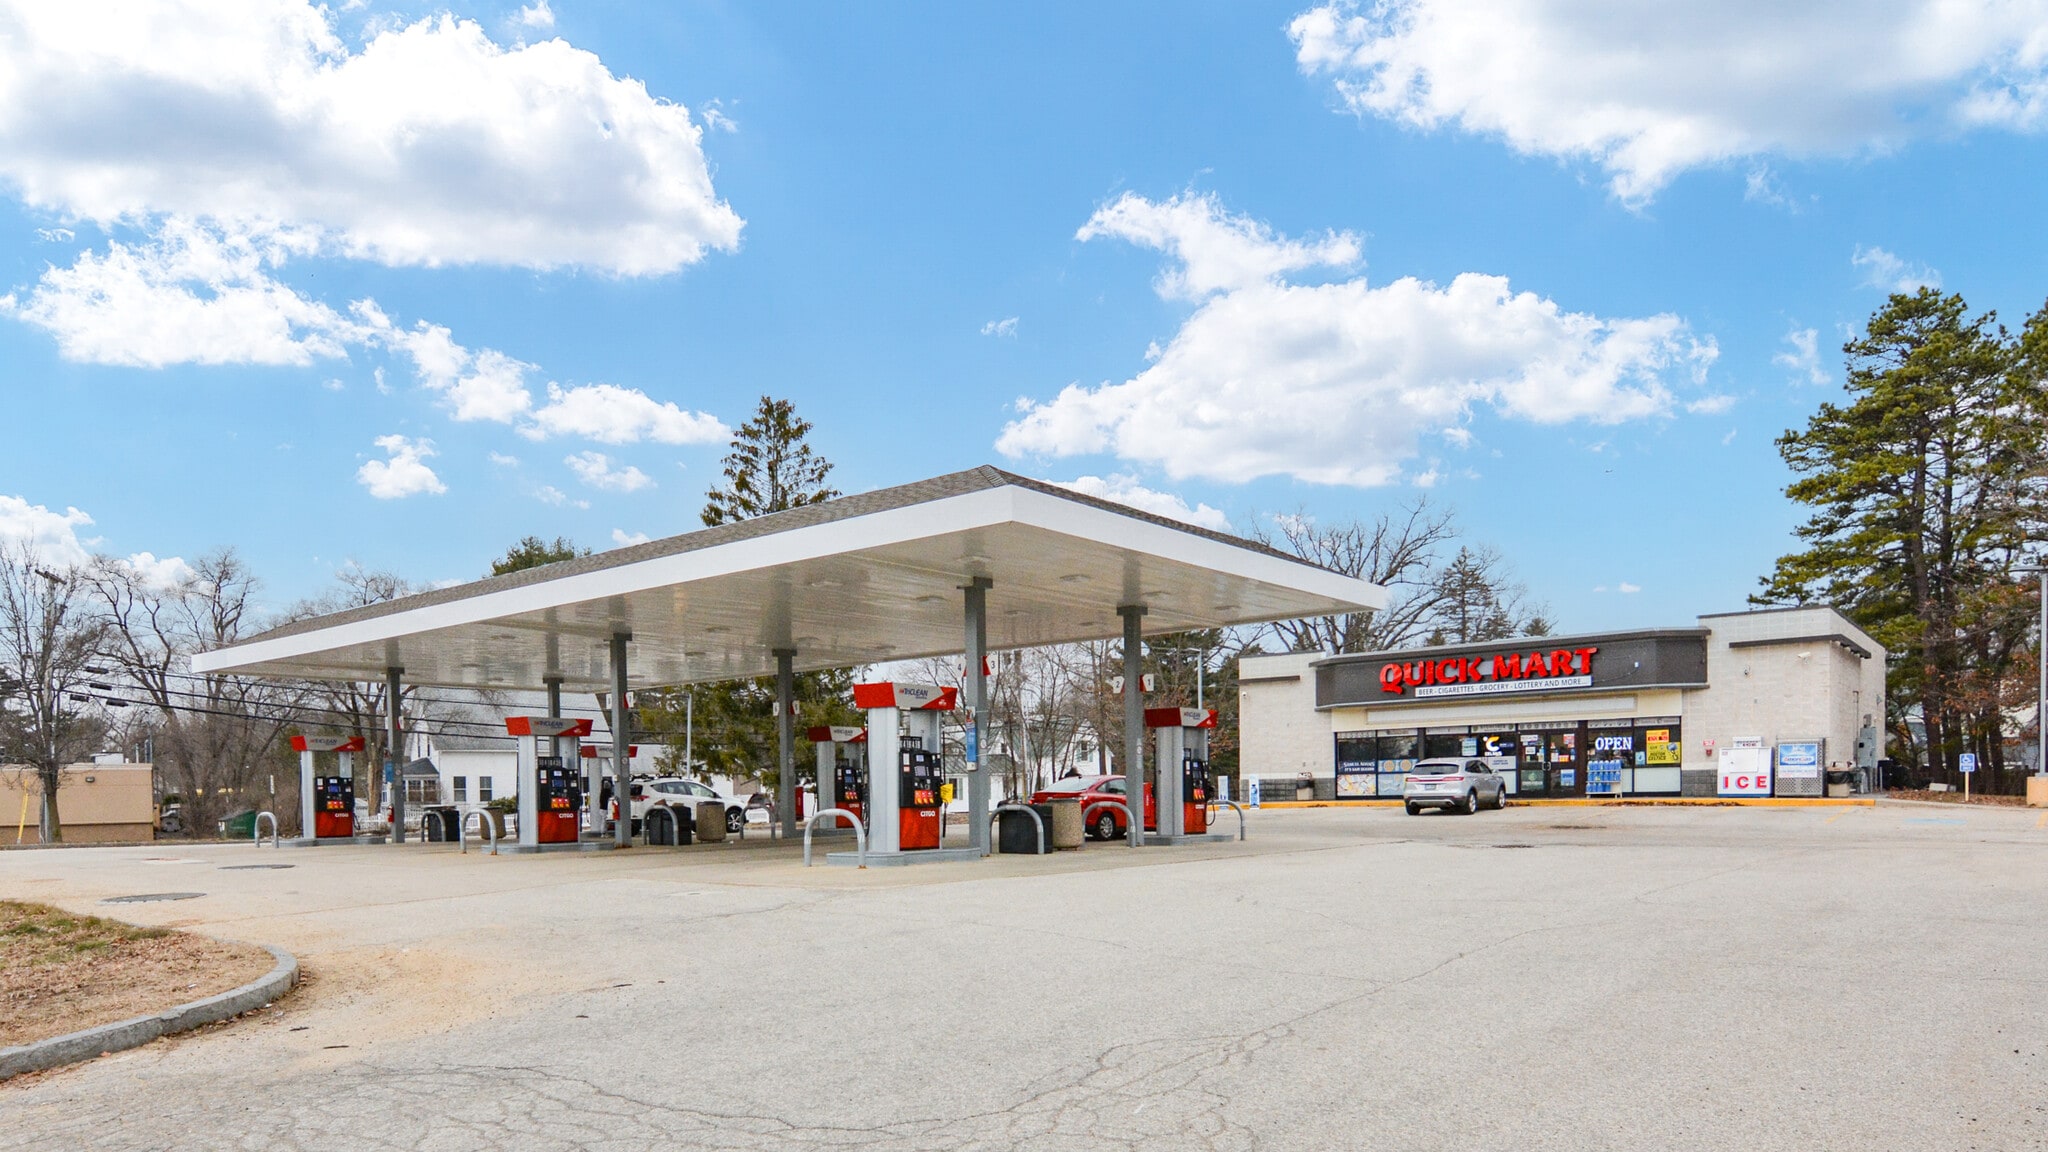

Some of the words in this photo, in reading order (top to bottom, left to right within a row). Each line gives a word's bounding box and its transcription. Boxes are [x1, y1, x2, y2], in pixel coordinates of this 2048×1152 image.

[991, 661, 996, 669] 3
[1379, 656, 1483, 694] QUICK
[1492, 647, 1598, 681] MART
[1438, 685, 1475, 694] CIGARETTES
[1479, 683, 1509, 692] GROCERY
[1514, 681, 1543, 690] LOTTERY
[1544, 679, 1560, 688] AND
[1595, 736, 1632, 750] OPEN
[1723, 775, 1768, 788] ICE
